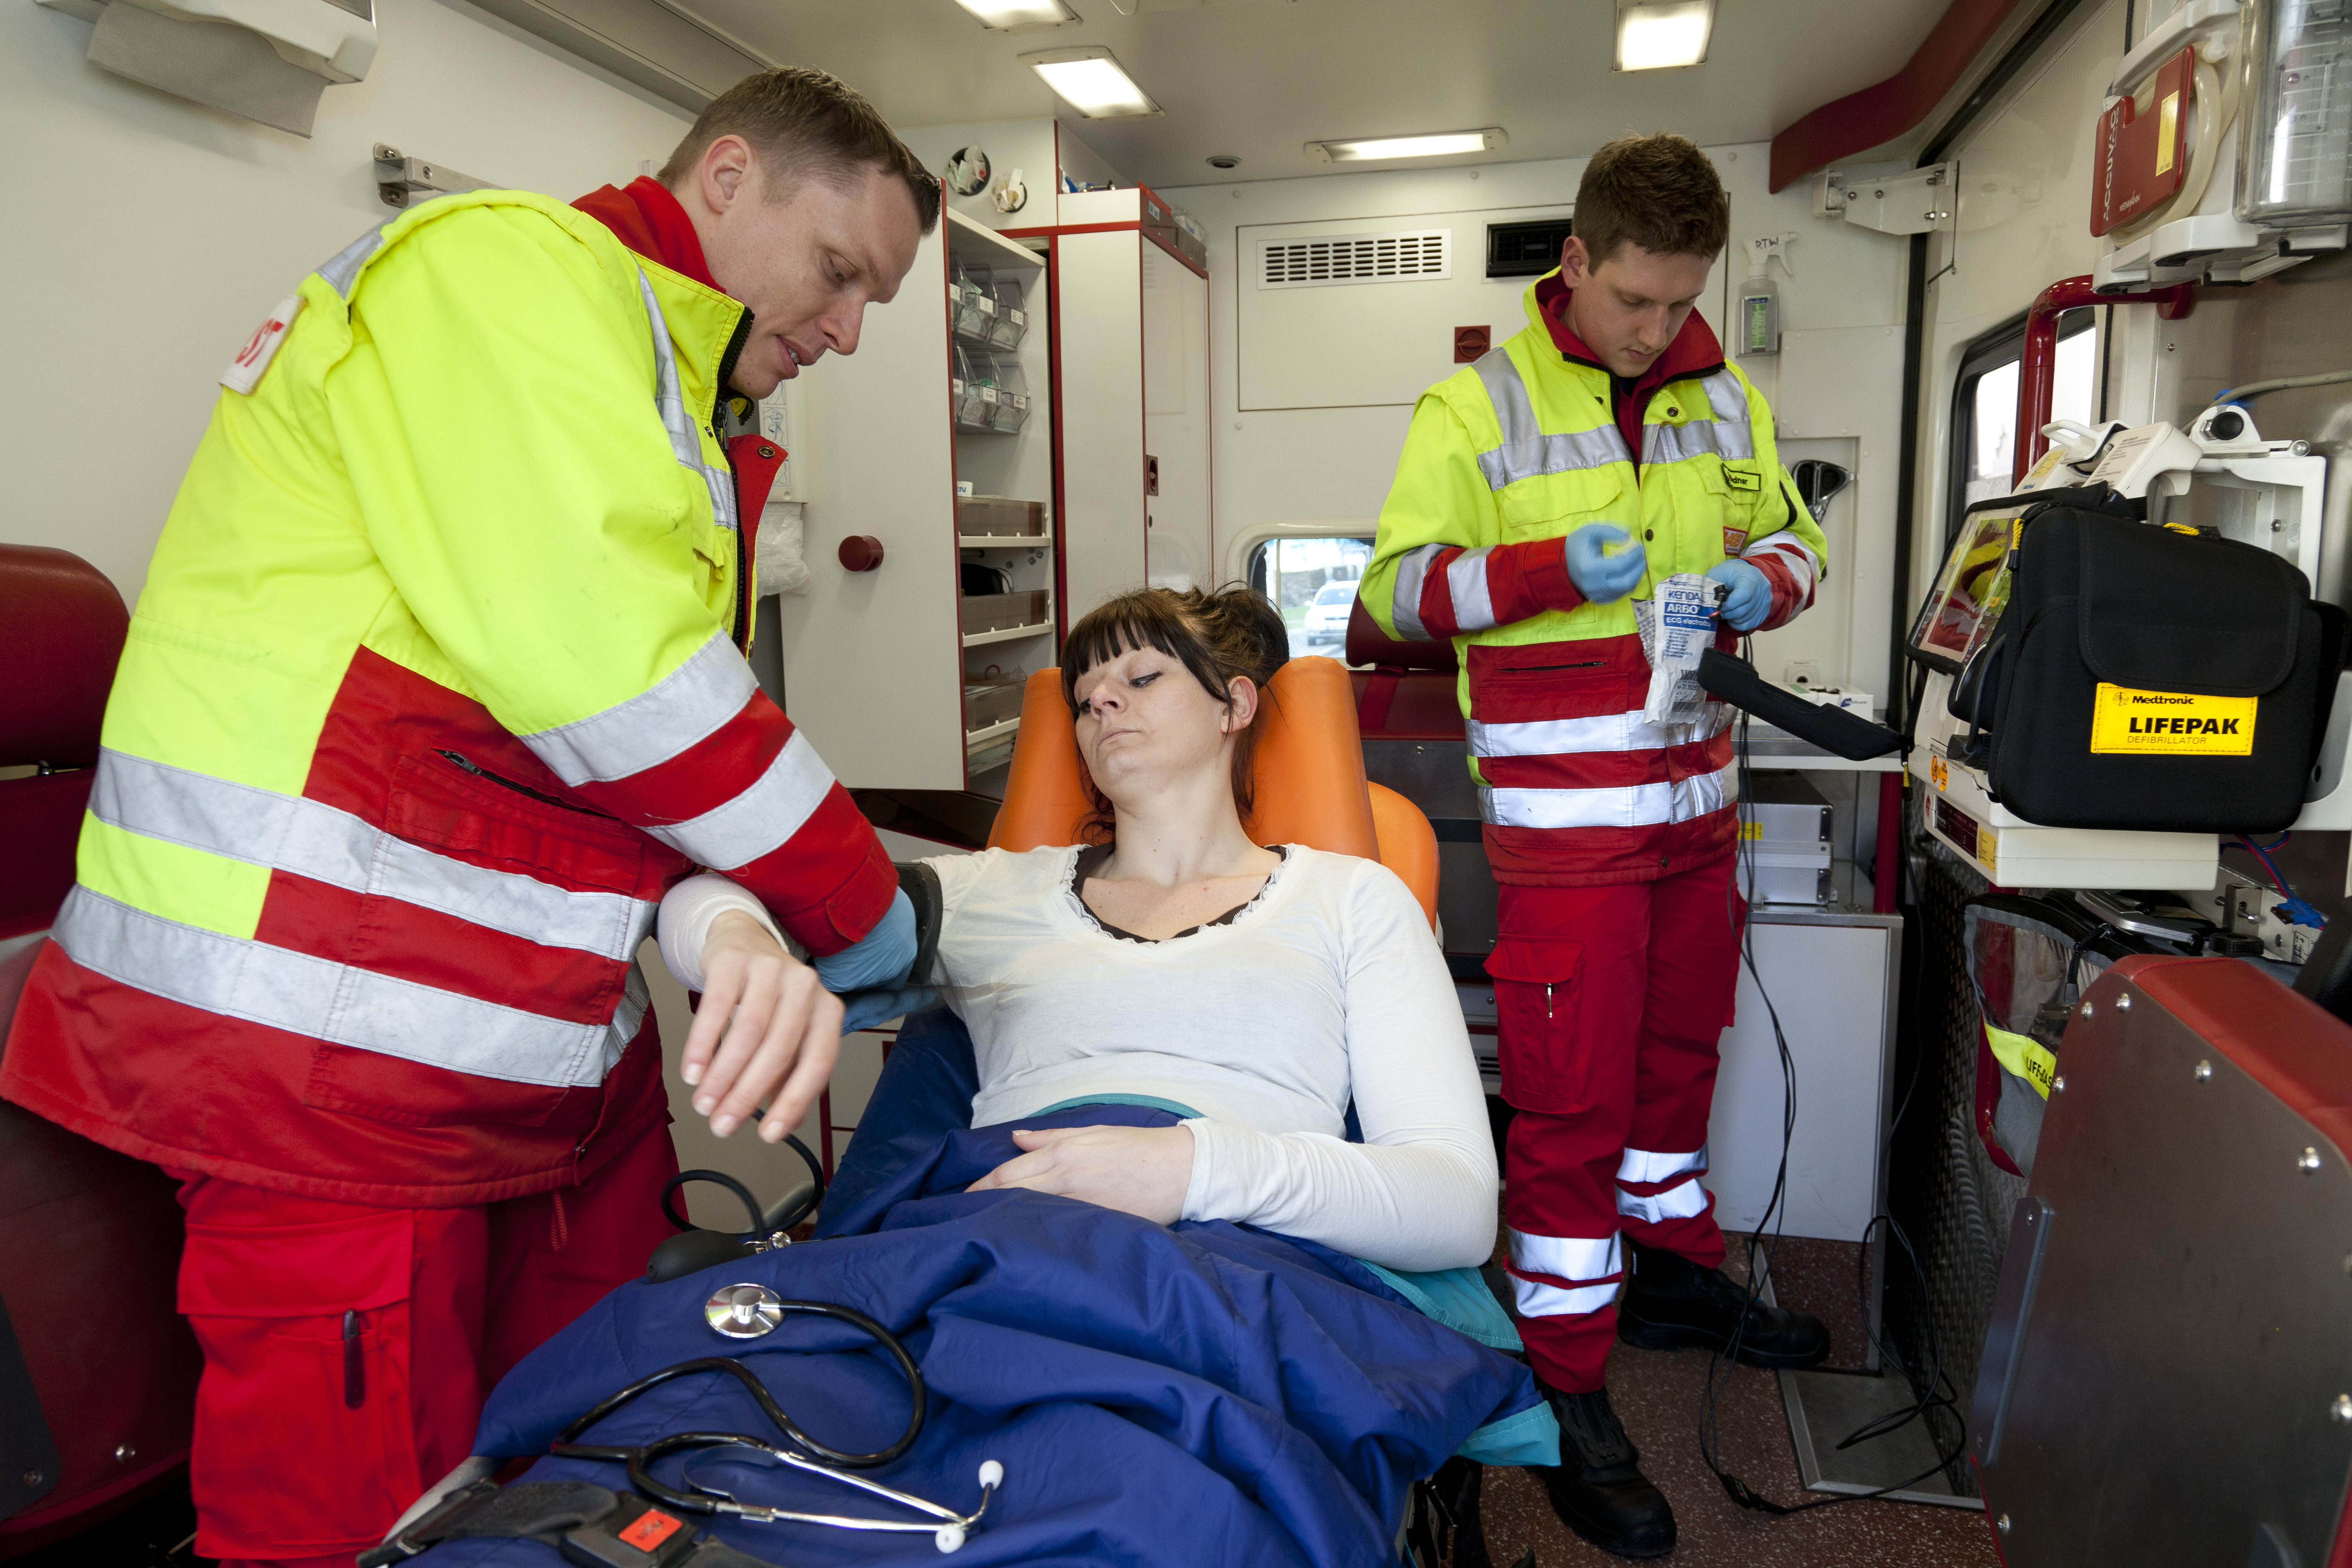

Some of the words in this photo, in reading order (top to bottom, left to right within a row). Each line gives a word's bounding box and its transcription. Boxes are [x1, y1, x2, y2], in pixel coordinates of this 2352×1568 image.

[1755, 237, 1779, 250] RTW
[1667, 603, 1699, 614] ARBO
[1683, 618, 1711, 627] electrodes
[2132, 696, 2195, 704] Medtronic
[2129, 717, 2240, 735] LIFEPAK
[2127, 735, 2206, 744] DEFIBRILLATOR
